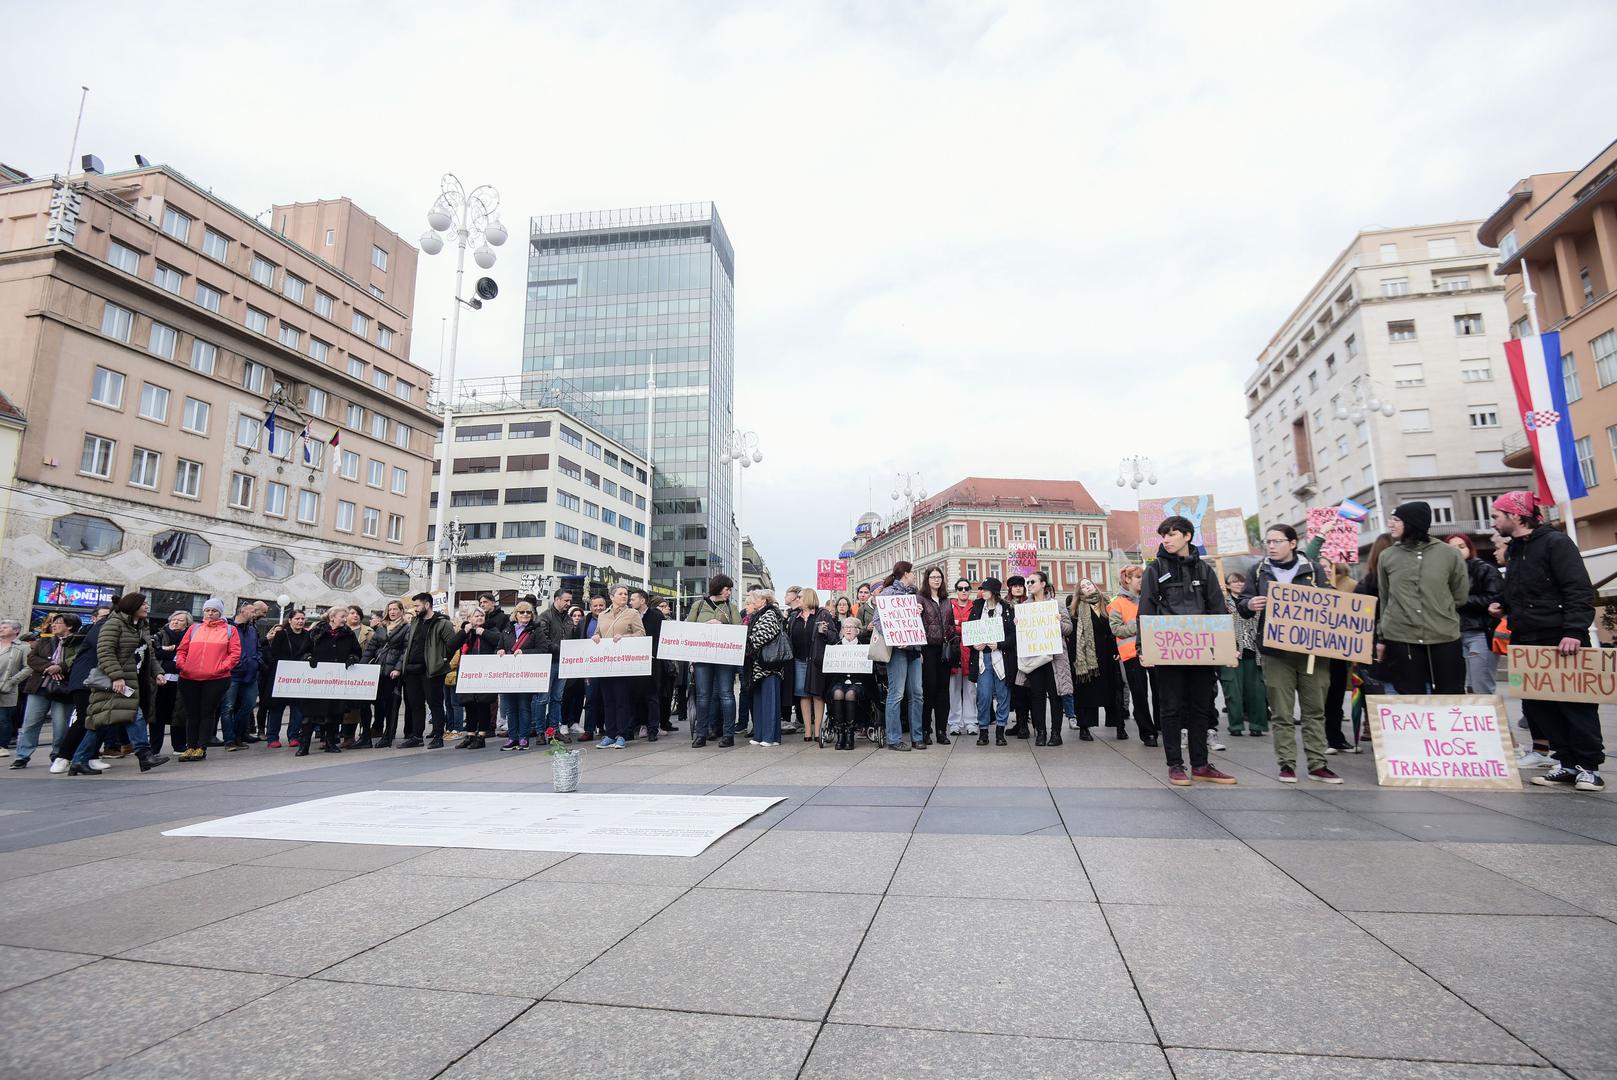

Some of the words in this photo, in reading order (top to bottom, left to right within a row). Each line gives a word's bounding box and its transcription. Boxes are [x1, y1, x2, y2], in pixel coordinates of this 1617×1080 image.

[74, 590, 113, 602] ONLINE
[878, 598, 886, 610] U
[890, 595, 917, 608] CRKVI
[1351, 598, 1362, 613] U
[883, 620, 895, 629] NA
[896, 618, 918, 629] TRGU
[1272, 602, 1373, 634] RAZMIŠLJANJU
[661, 637, 680, 646] Zagreb
[1154, 631, 1216, 647] SPASITI
[1267, 622, 1285, 644] NE
[1289, 625, 1364, 658] ODIJEVANJU
[562, 656, 584, 665] Zagreb
[585, 654, 649, 664] #SafePlace4Women
[277, 676, 301, 685] Zagreb
[460, 671, 483, 680] Zagreb
[483, 671, 548, 680] #SafePlace4Women
[1522, 671, 1555, 693] NA
[1561, 671, 1616, 696] MIRU
[1380, 707, 1437, 732] PRAVE
[1448, 707, 1495, 732] ŽENE
[1424, 737, 1478, 757] NOSE
[1388, 759, 1508, 777] TRANSPARENTE
